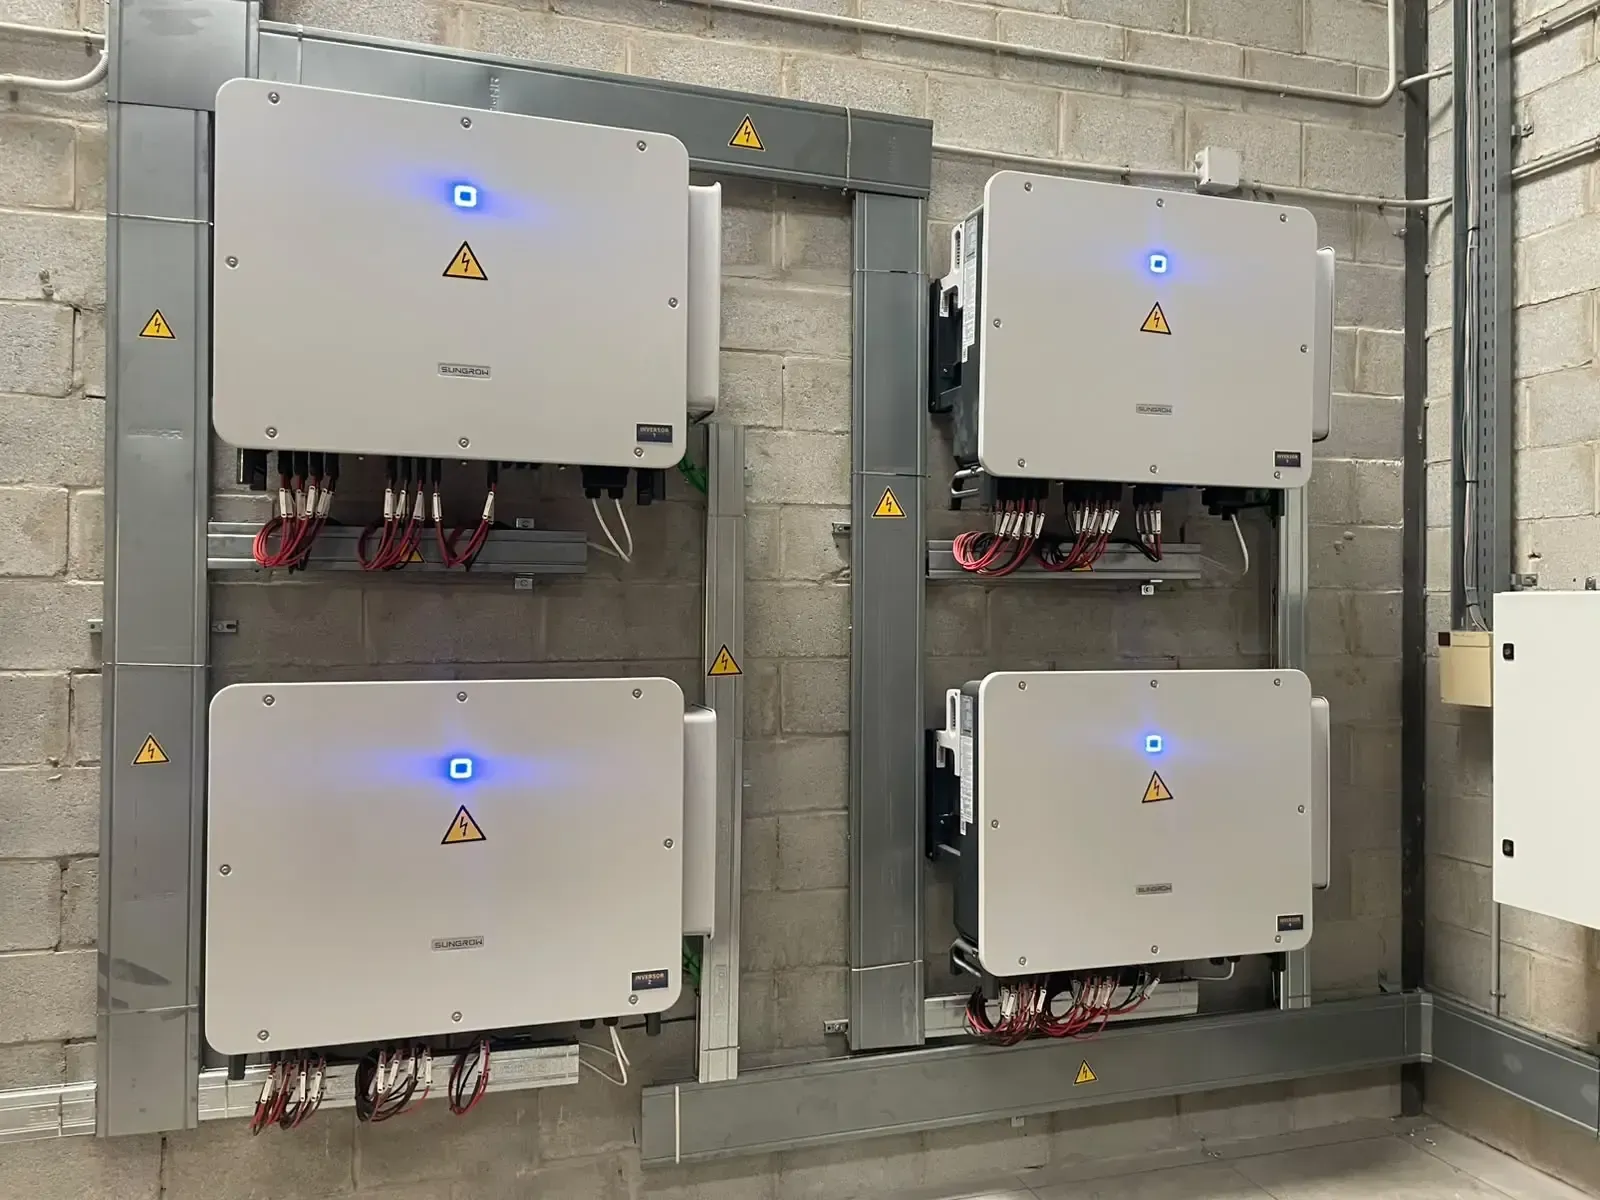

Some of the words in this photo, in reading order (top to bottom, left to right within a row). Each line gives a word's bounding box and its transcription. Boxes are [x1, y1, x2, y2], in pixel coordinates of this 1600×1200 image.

[441, 366, 489, 375] SUNGROW
[434, 939, 483, 948] SUNGROW
[635, 973, 664, 981] INVERSOR
